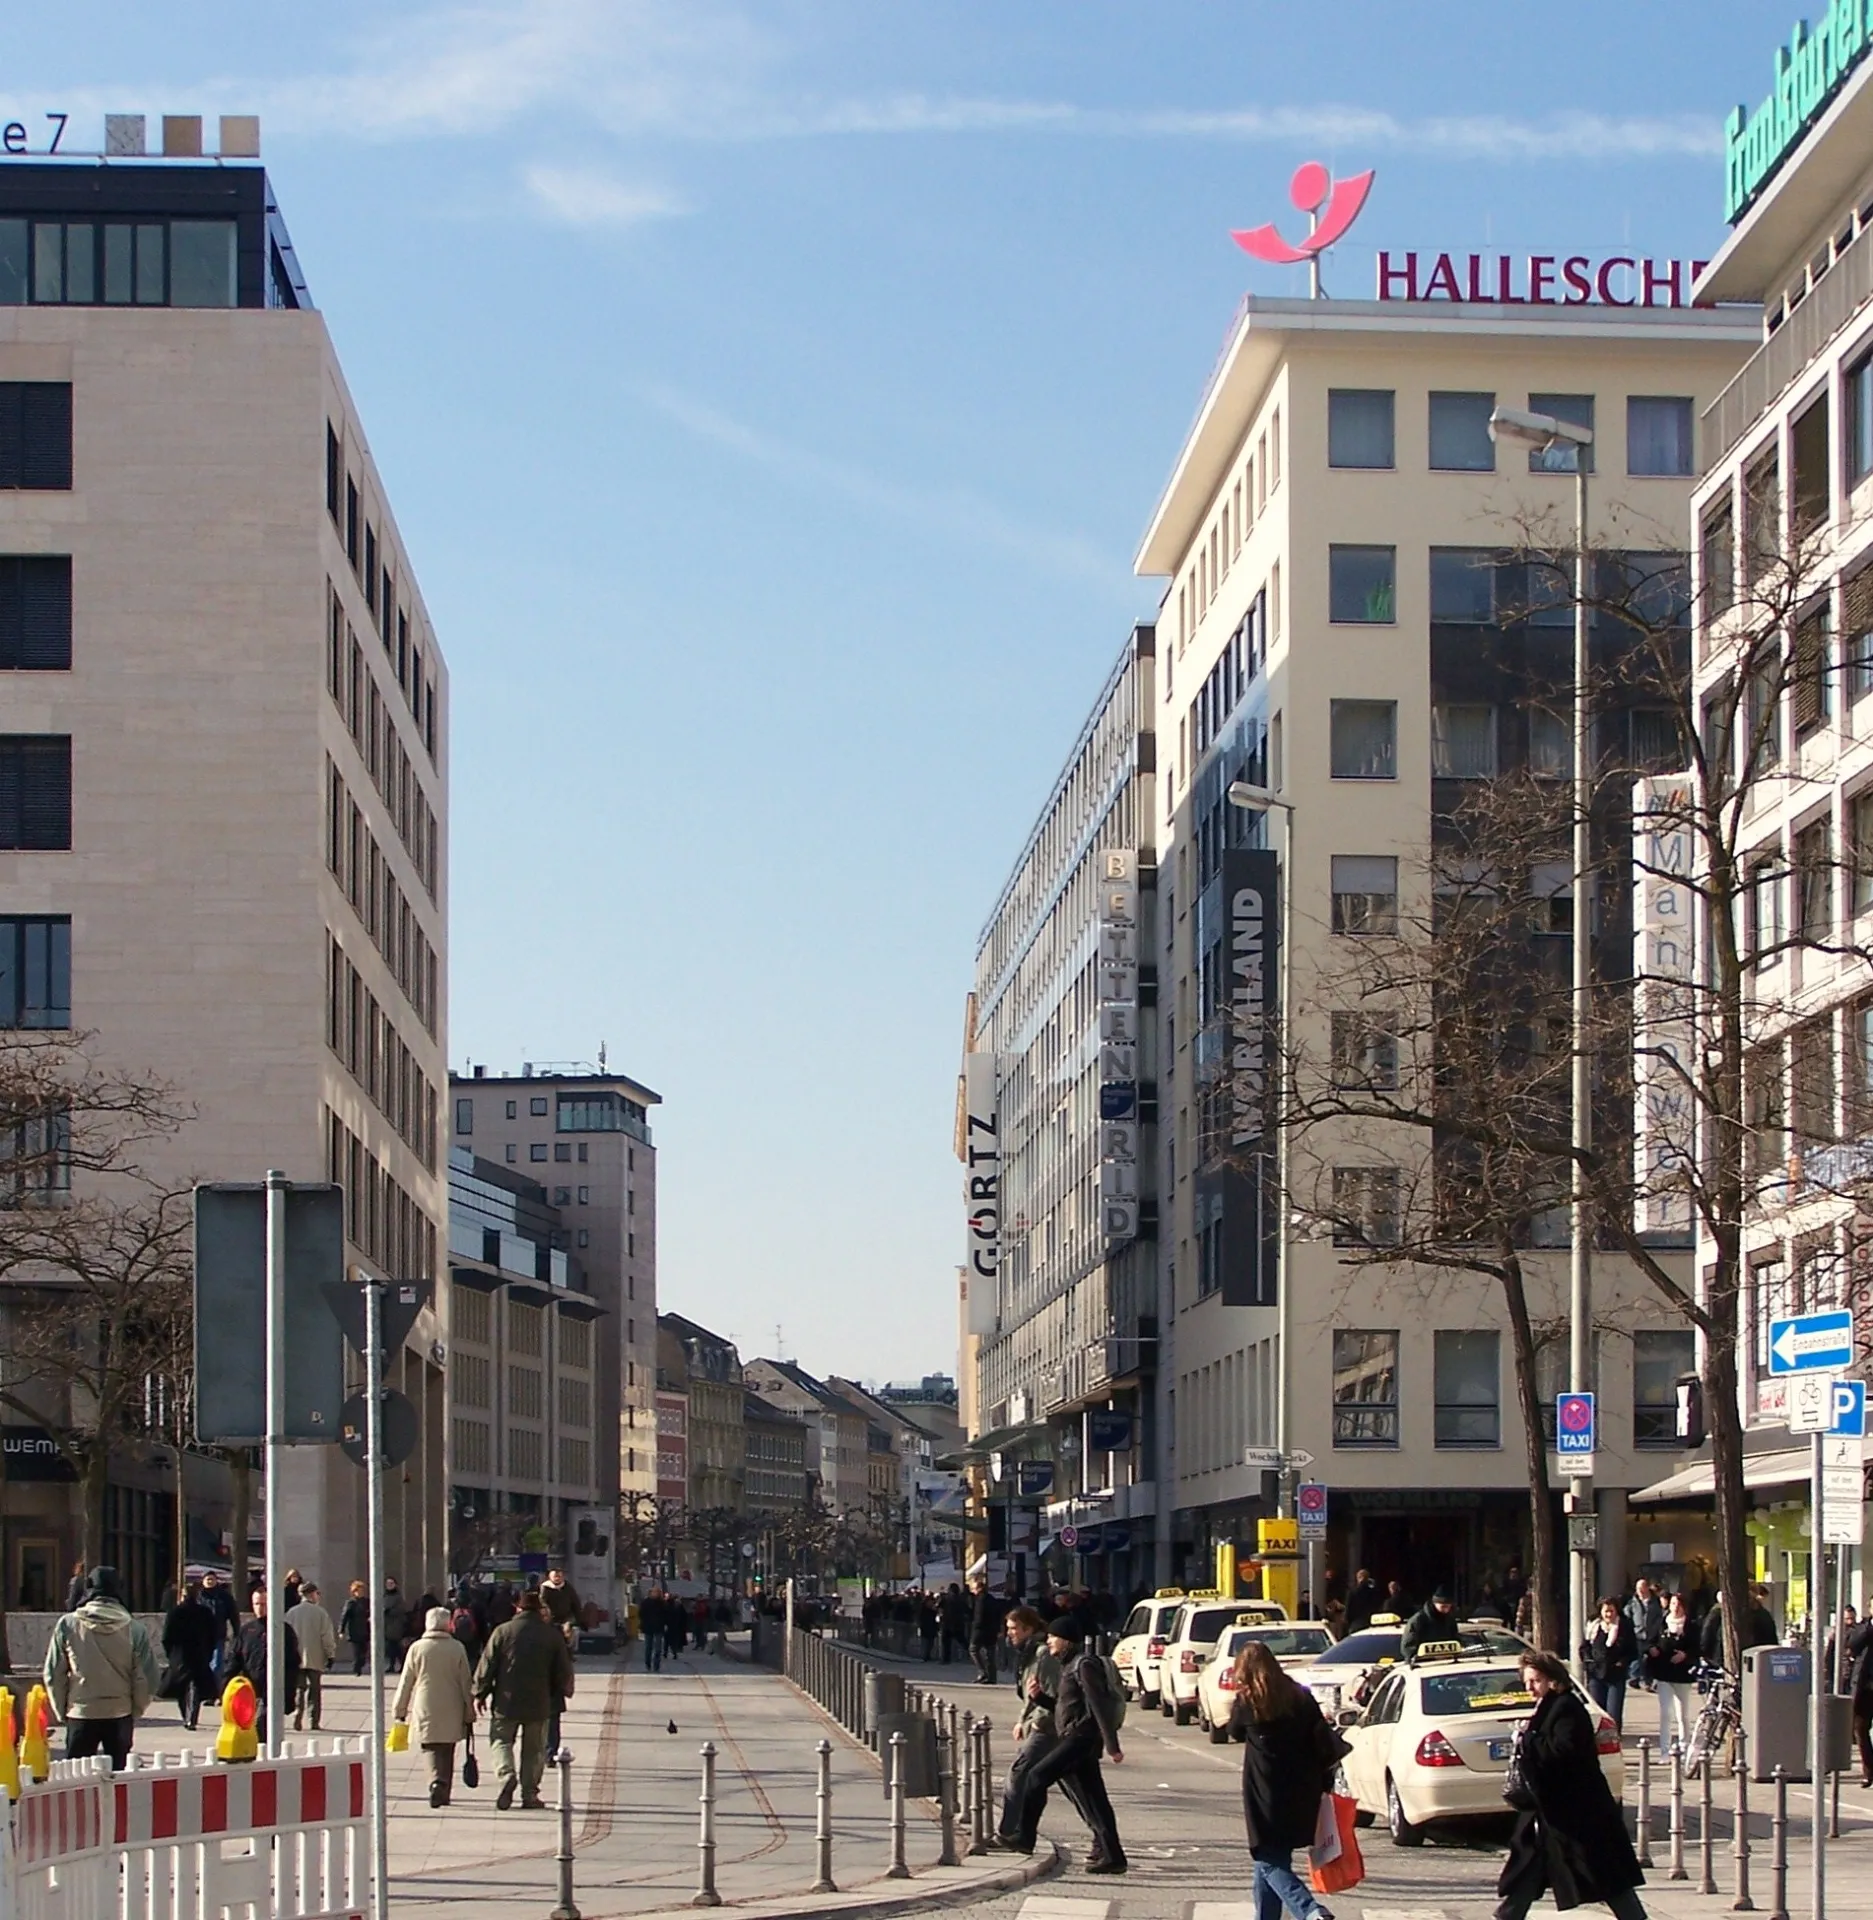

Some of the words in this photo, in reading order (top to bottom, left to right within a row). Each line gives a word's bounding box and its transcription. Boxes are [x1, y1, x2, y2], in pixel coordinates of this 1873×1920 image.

[1232, 887, 1264, 1147] WORMLAND
[1651, 833, 1682, 1220] Manower
[967, 1112, 998, 1278] GÖRTZ
[1561, 1434, 1590, 1448] TAXI
[1301, 1511, 1325, 1523] TAXI
[1264, 1538, 1297, 1550] TAXI
[1425, 1642, 1458, 1654] TAXI
